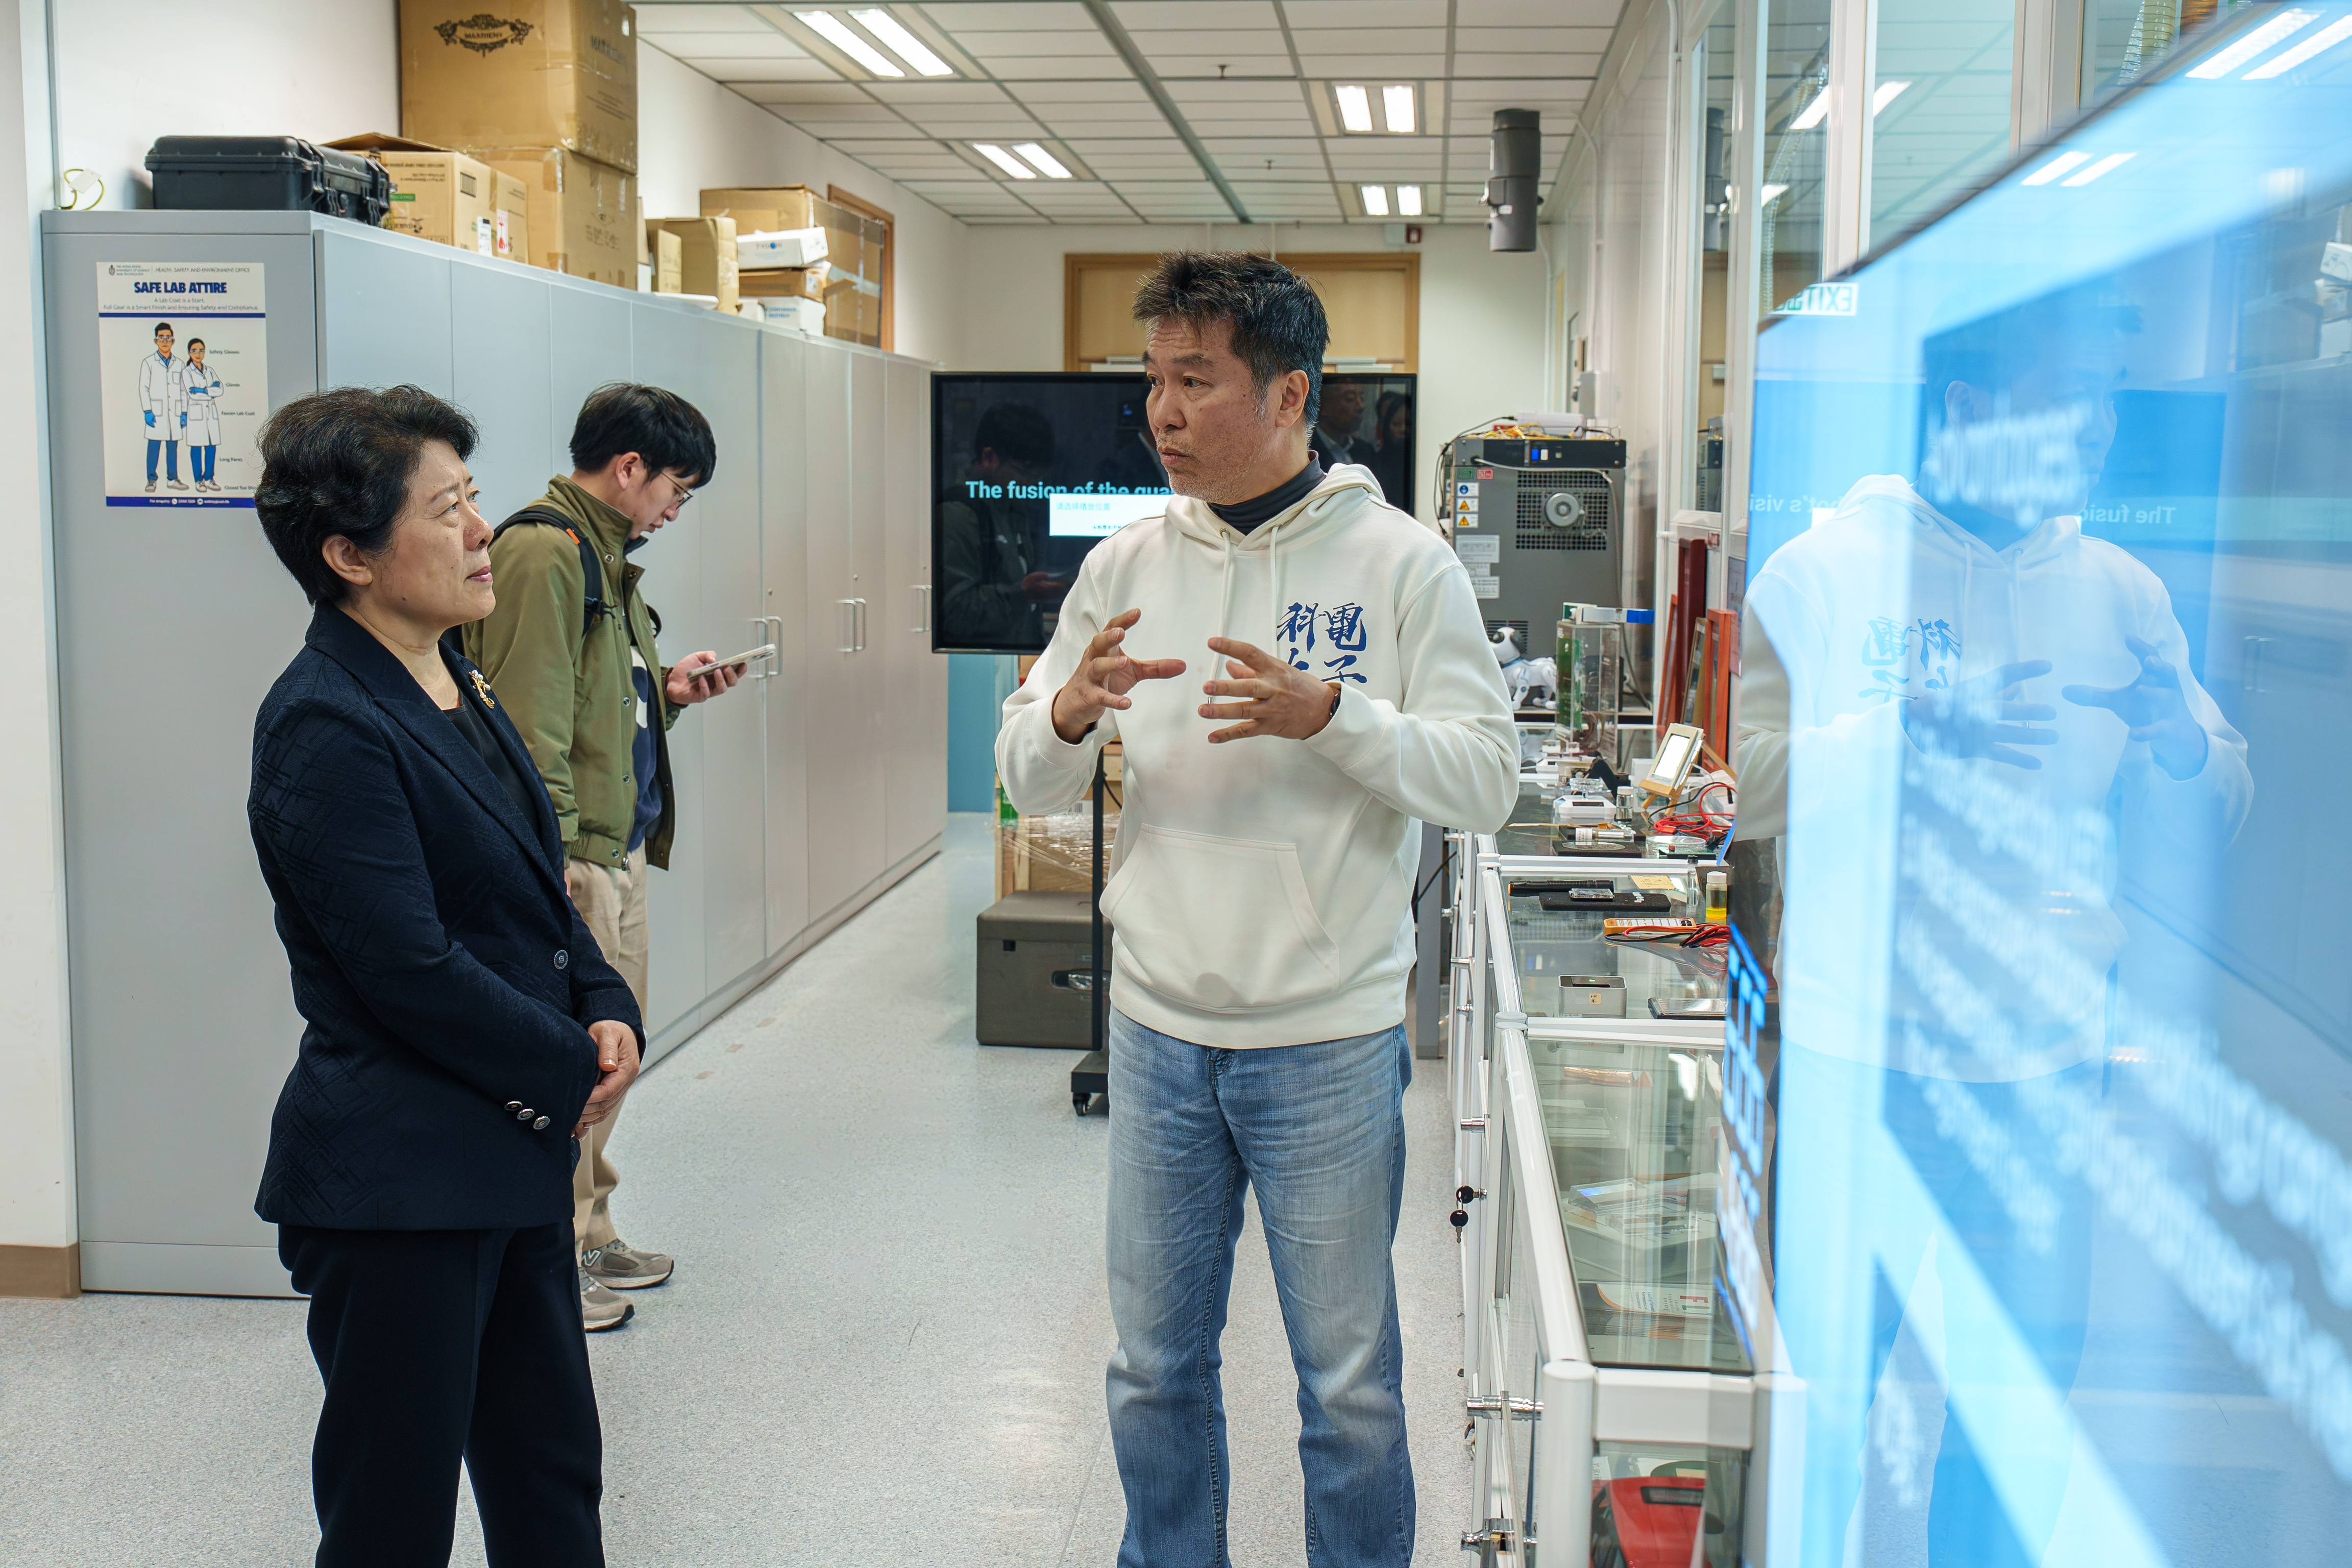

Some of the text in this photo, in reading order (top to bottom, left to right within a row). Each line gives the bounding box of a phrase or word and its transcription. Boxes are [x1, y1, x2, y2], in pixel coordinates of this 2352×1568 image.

[134, 281, 227, 293] SAFE LAB ATTIRE
[965, 480, 1002, 499] The
